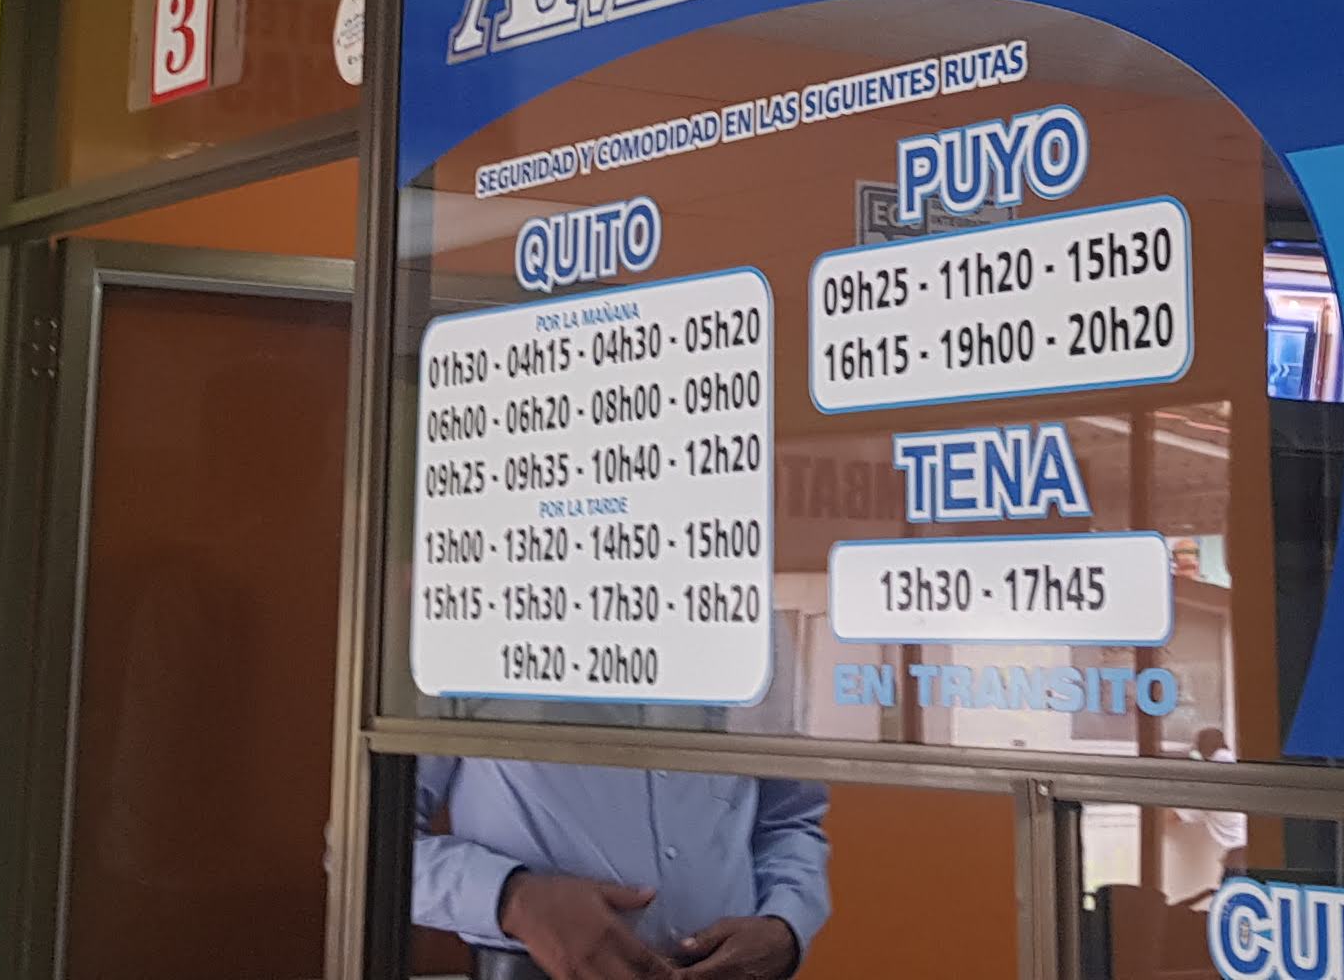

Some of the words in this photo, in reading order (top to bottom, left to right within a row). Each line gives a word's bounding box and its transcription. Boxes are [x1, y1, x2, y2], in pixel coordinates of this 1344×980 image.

[478, 150, 575, 195] SEGURIDAD
[579, 146, 595, 170] Y
[597, 115, 718, 166] COMODIDAD
[725, 105, 753, 138] EN
[760, 96, 797, 129] LAS
[804, 63, 937, 119] SIGUIENTES
[945, 42, 1026, 88] RUTAS
[902, 111, 1084, 217] PUYO
[517, 200, 659, 289] QUITO
[821, 265, 910, 319] 09h25
[937, 246, 1035, 302] 11h20
[1065, 225, 1174, 285] 15h30
[427, 347, 490, 391] 01h30
[505, 335, 573, 380] 04h15
[590, 320, 663, 369] 04h30
[683, 305, 762, 355] 05h20
[822, 332, 911, 384] 16h15
[938, 317, 1036, 371] 19h00
[1066, 300, 1176, 359] 20h20
[425, 402, 489, 445] 06h00
[504, 392, 572, 437] 06h20
[590, 381, 663, 428] 08h00
[683, 368, 762, 417] 09h00
[424, 459, 487, 500] 09h25
[503, 451, 571, 493] 09h35
[589, 441, 663, 487] 10h40
[683, 431, 763, 478] 12h20
[897, 429, 1086, 518] TENA
[424, 526, 485, 565] 13h00
[503, 523, 570, 564] 13h20
[590, 520, 662, 562] 14h50
[683, 516, 762, 561] 15h00
[422, 583, 484, 622] 15h15
[502, 581, 568, 623] 15h30
[588, 581, 661, 624] 17h30
[682, 580, 761, 625] 18h20
[879, 565, 973, 613] 13h30
[1002, 562, 1107, 613] 17h45
[500, 641, 567, 684] 19h20
[586, 642, 660, 687] 20h00
[833, 664, 896, 707] EN
[909, 664, 1179, 717] TRANSITO
